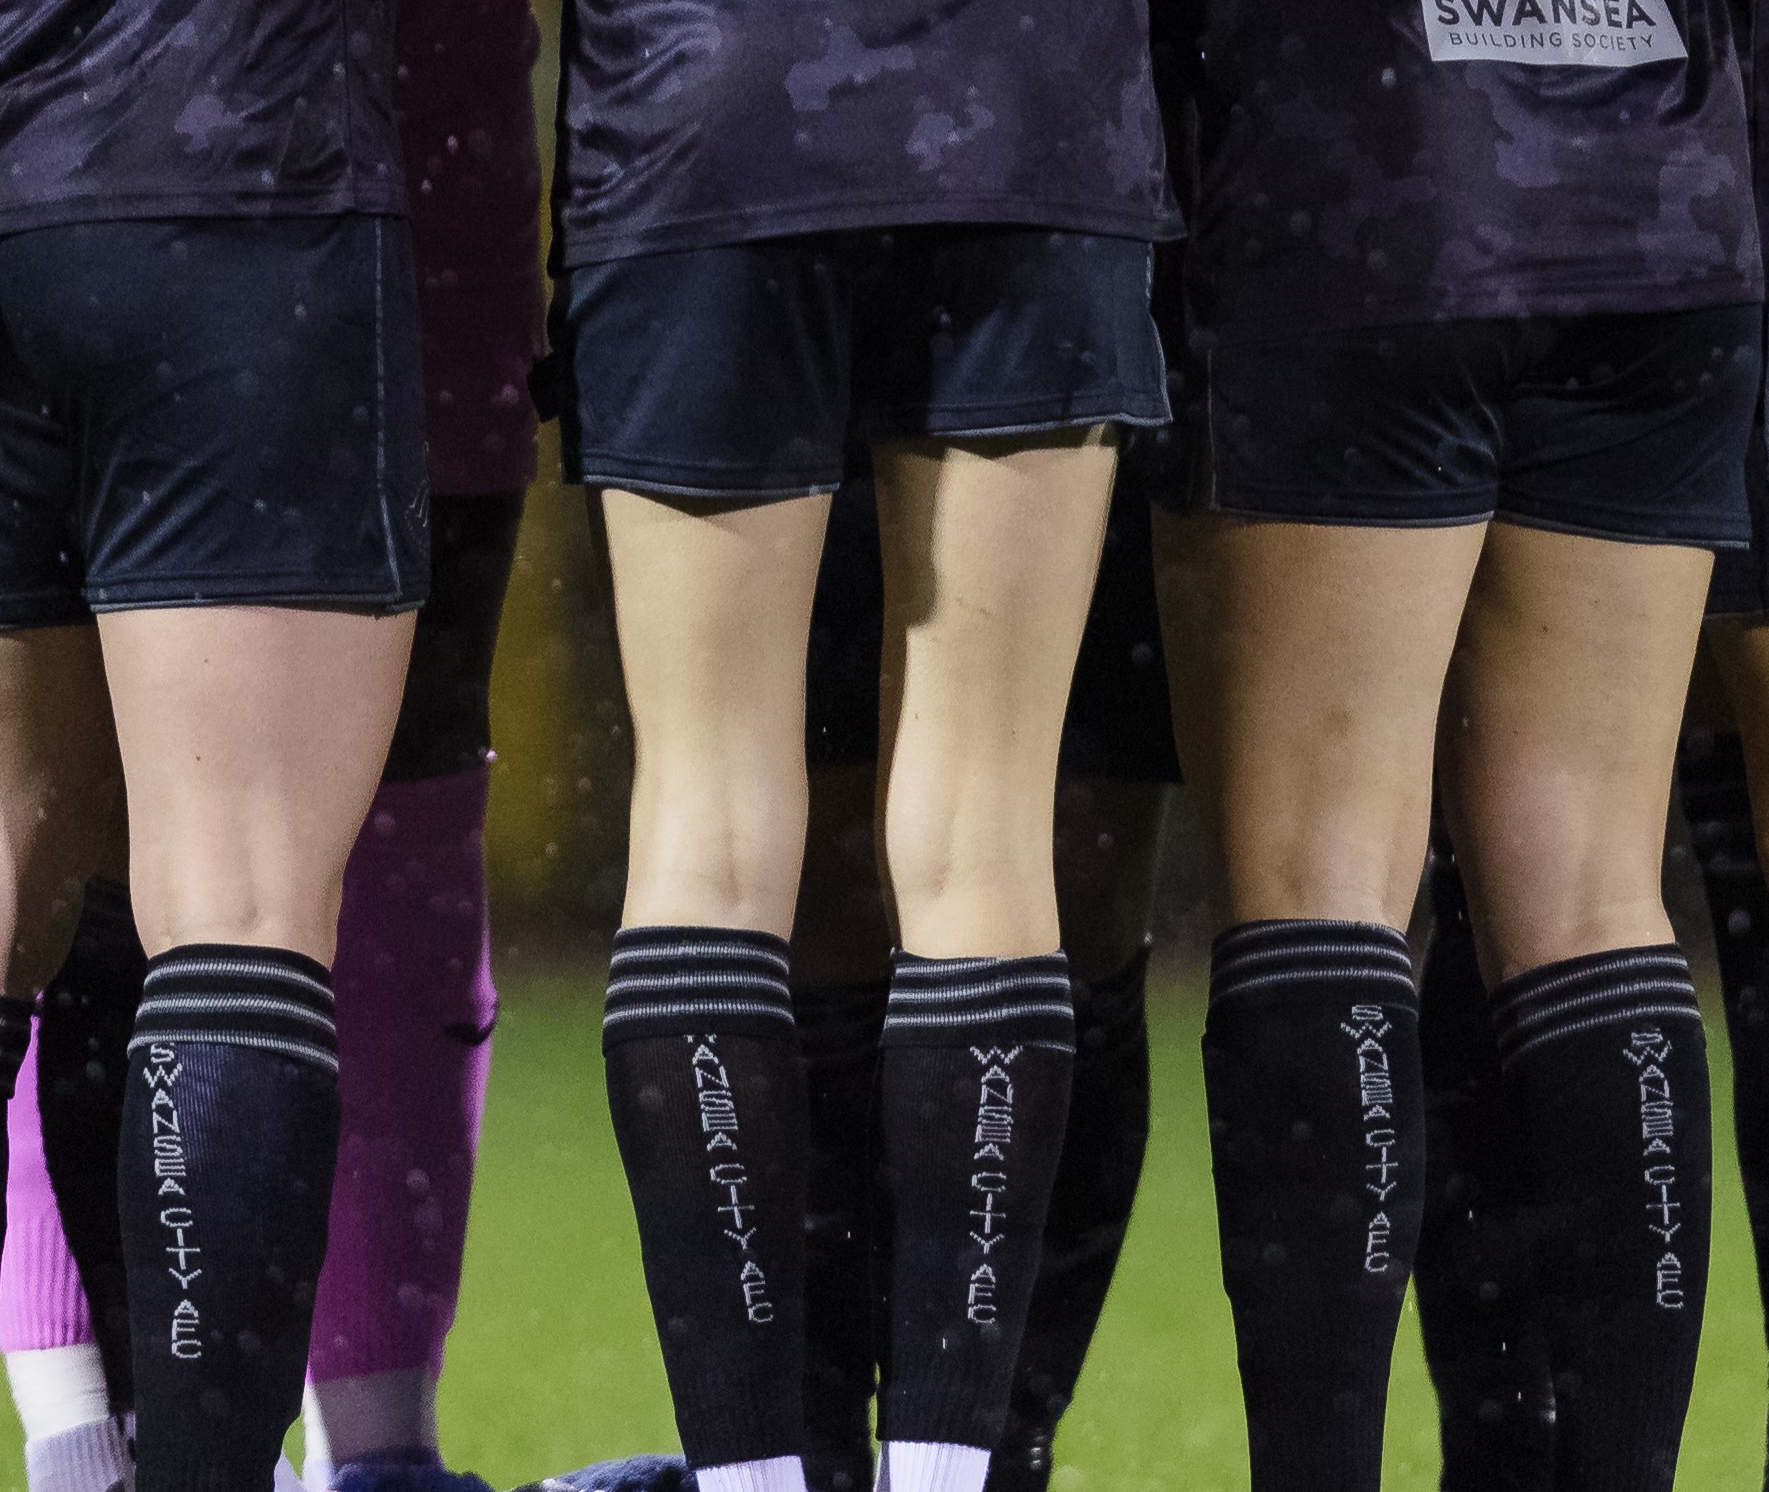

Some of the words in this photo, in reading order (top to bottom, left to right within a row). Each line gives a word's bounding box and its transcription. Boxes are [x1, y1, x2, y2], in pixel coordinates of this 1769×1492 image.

[1449, 32, 1563, 49] BUILDING
[1572, 34, 1654, 51] SOCIETY
[1340, 1004, 1393, 1121] SWANSEA
[1623, 1028, 1674, 1157] SWANSEA
[143, 1043, 186, 1196] SWANSEA
[1365, 1128, 1399, 1201] CITY
[970, 1172, 1007, 1254] CITY
[1365, 1211, 1391, 1273] AFC
[1644, 1165, 1681, 1243] CITY
[160, 1208, 202, 1290] CITY
[710, 1164, 757, 1250] CITY
[741, 1261, 774, 1323] AFC
[1656, 1252, 1684, 1309] AFC
[171, 1299, 202, 1359] AFC
[968, 1263, 997, 1325] AFC
